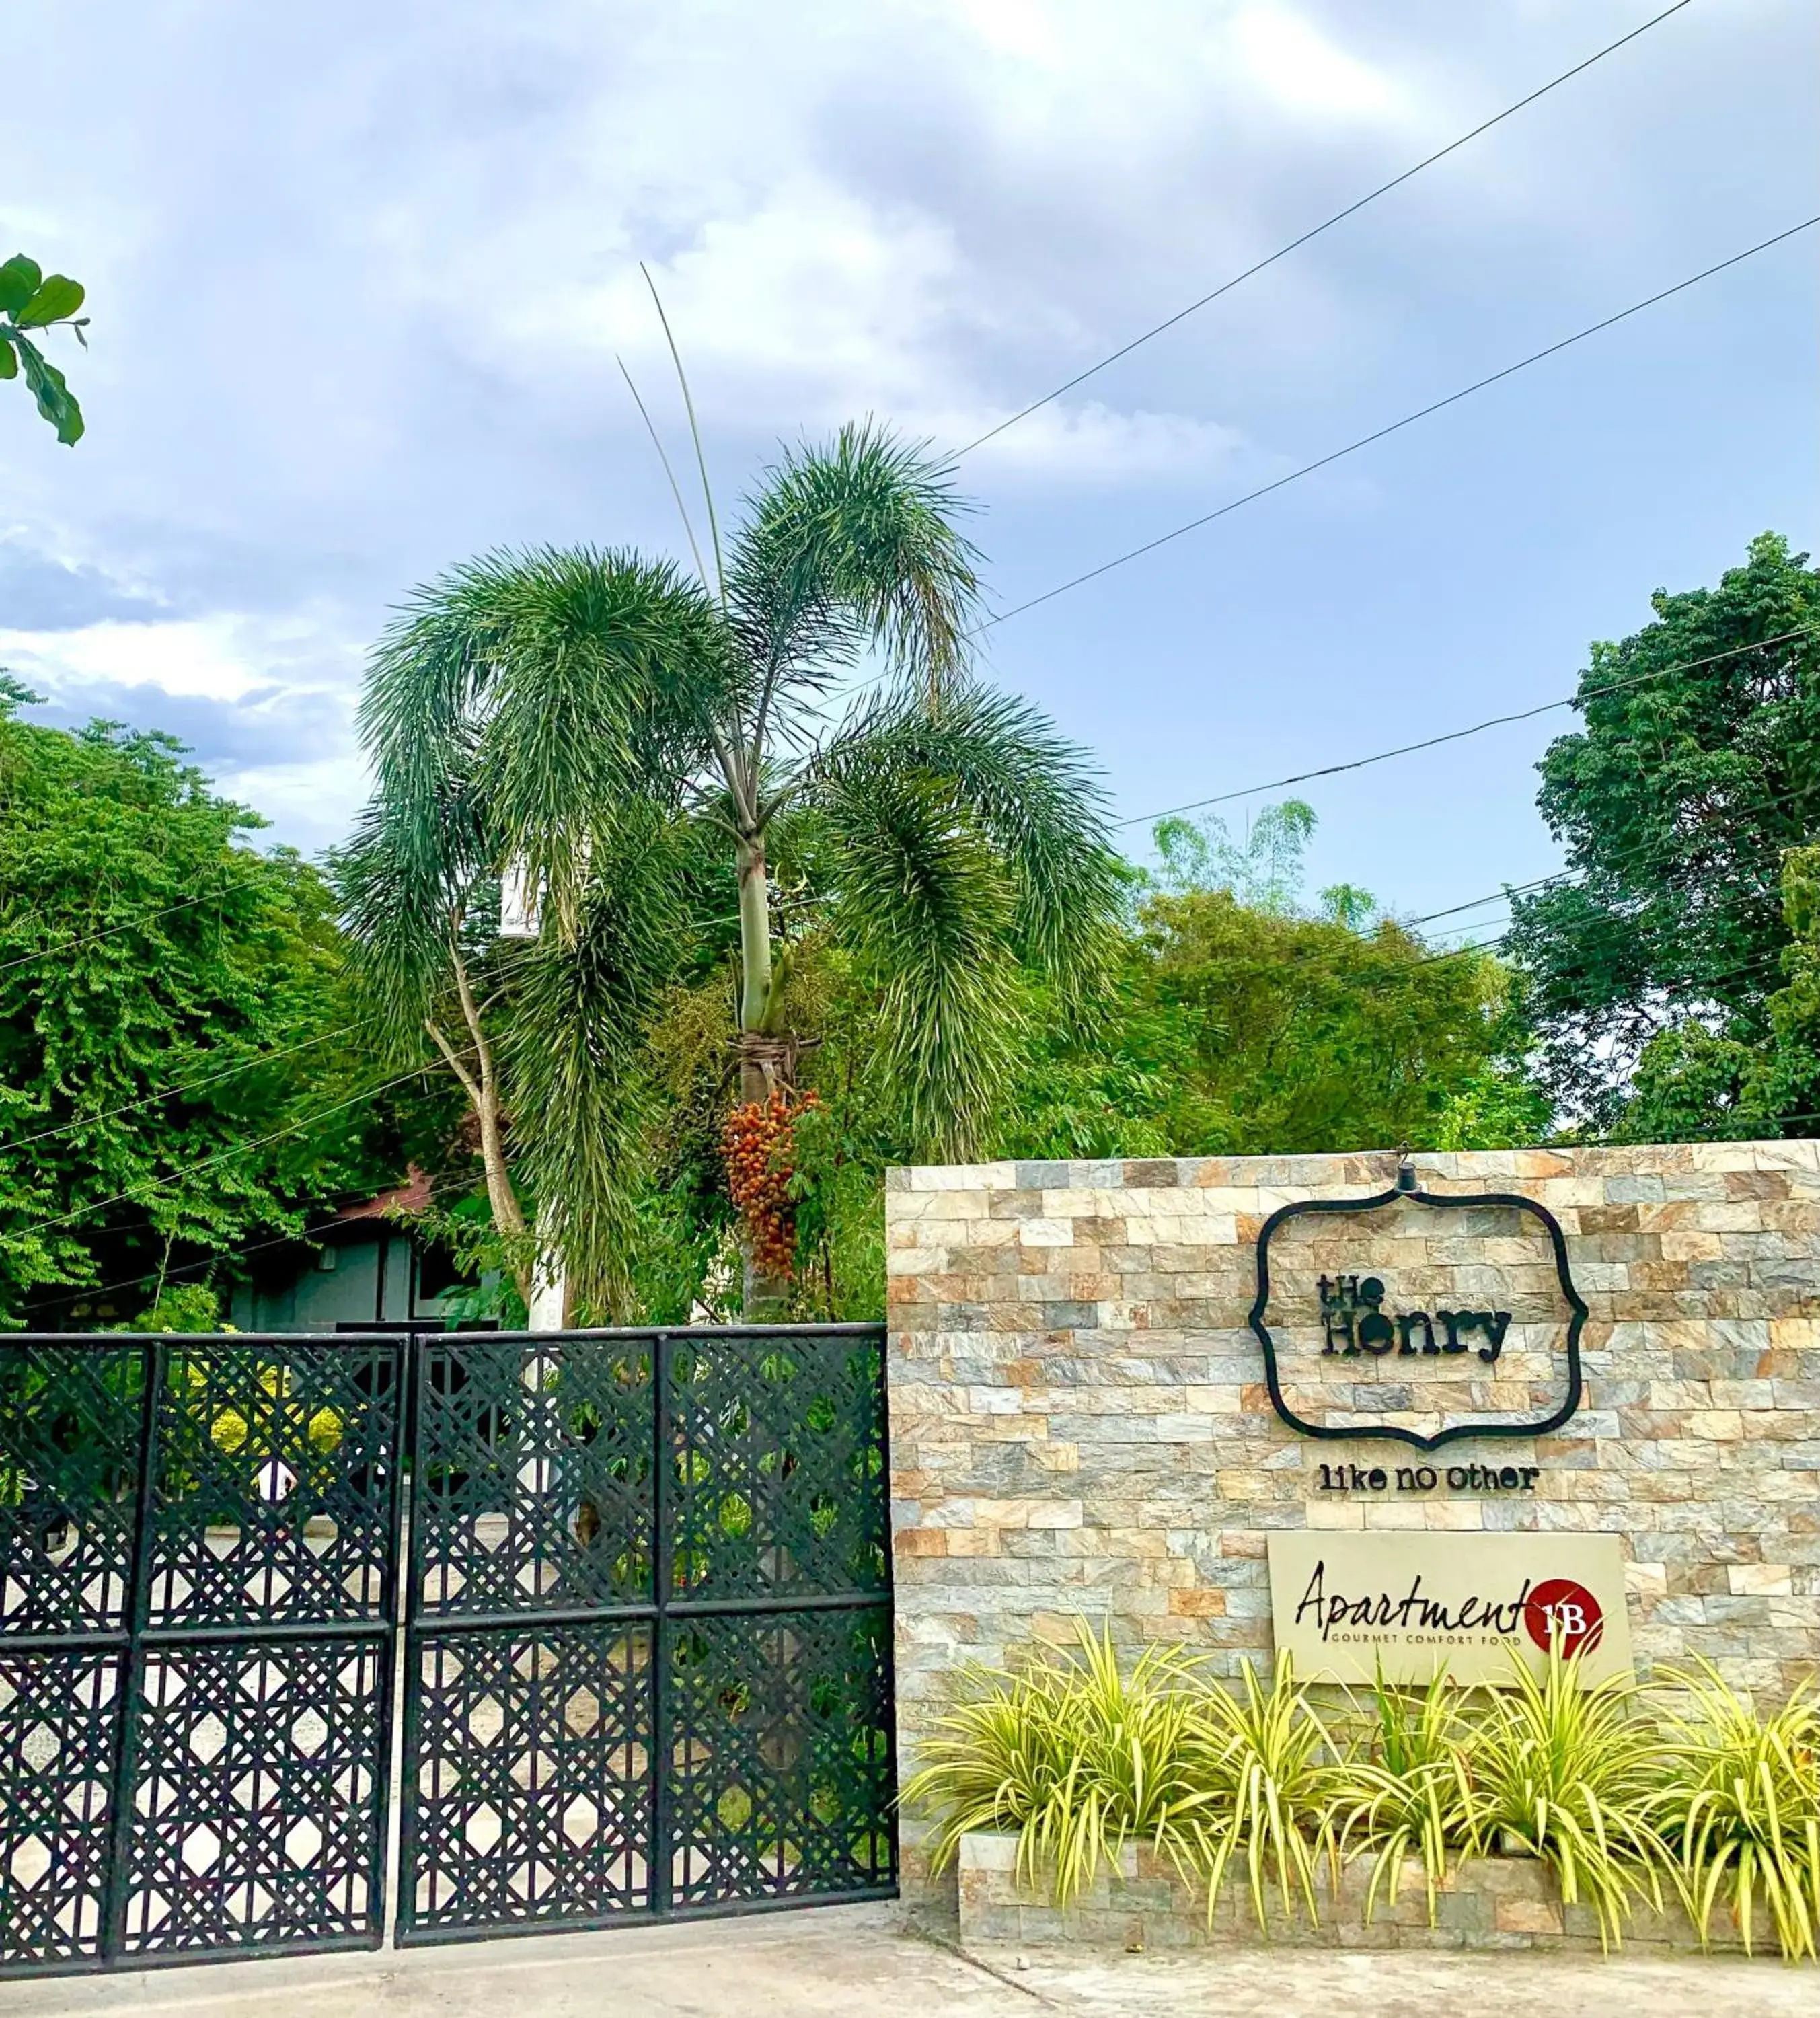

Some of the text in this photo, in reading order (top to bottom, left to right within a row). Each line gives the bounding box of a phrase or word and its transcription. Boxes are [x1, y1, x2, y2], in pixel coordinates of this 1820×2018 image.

[1320, 1310, 1512, 1363] Henry
[1319, 1463, 1540, 1491] like no other
[1295, 1561, 1535, 1641] Apartment
[1332, 1633, 1397, 1643] GOURMET
[1406, 1634, 1473, 1645] COMFORT
